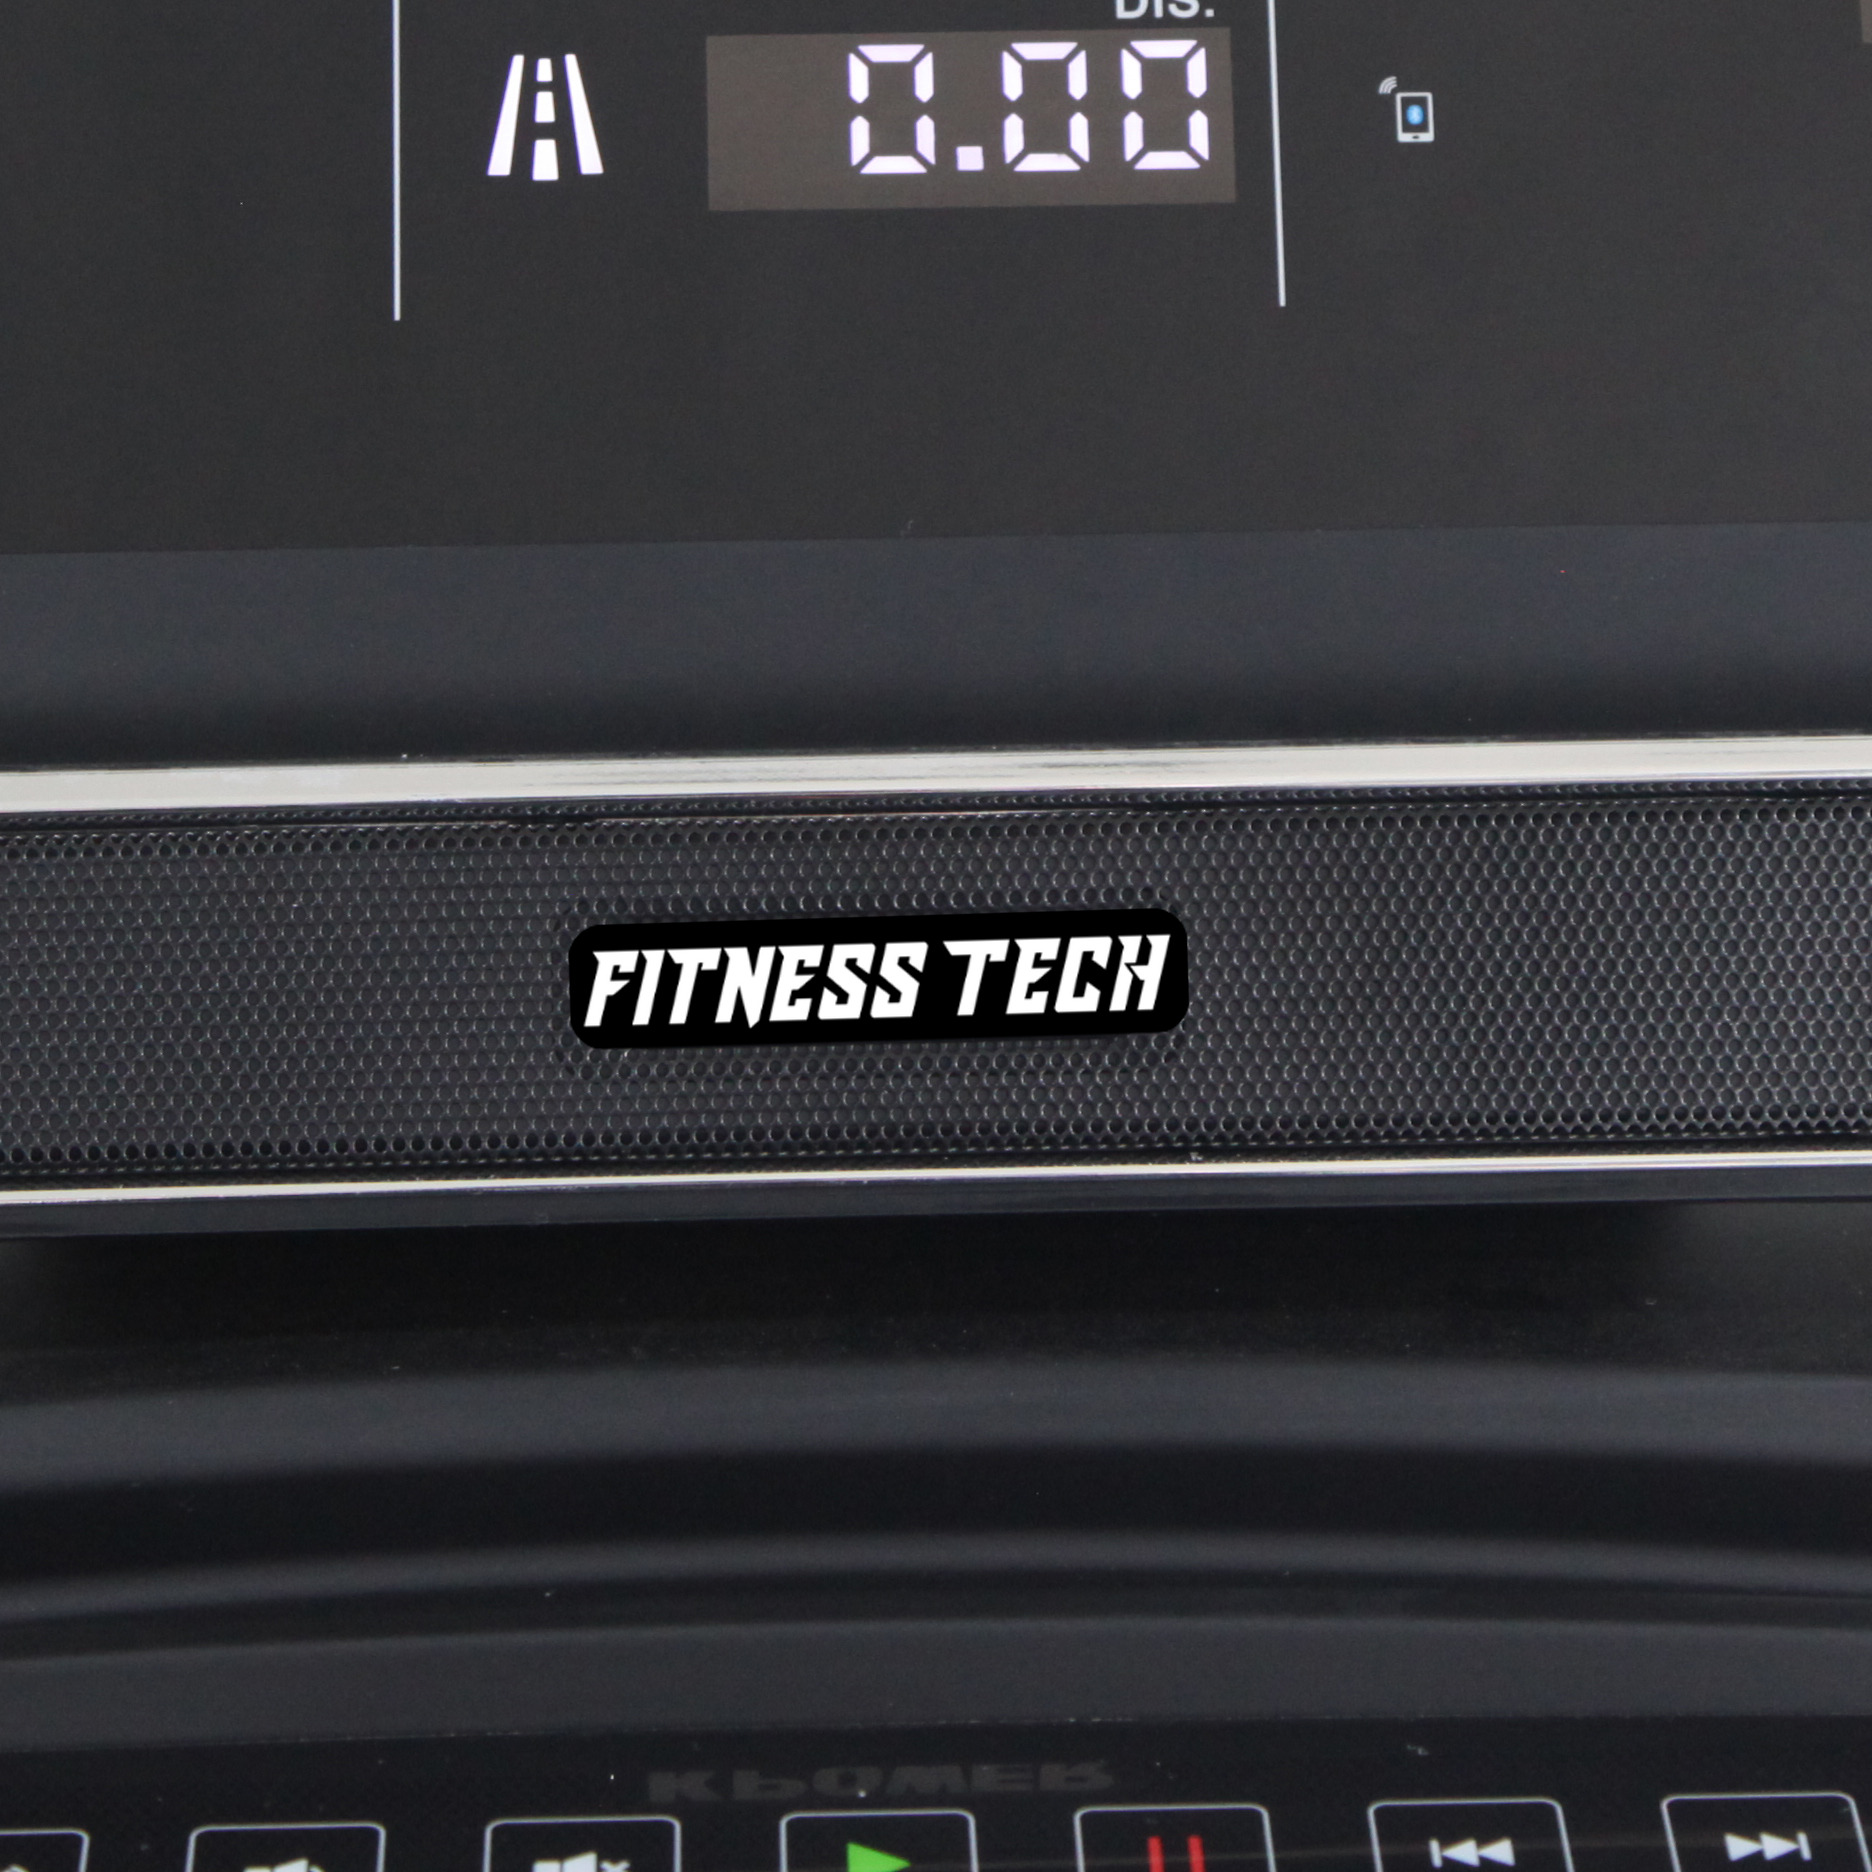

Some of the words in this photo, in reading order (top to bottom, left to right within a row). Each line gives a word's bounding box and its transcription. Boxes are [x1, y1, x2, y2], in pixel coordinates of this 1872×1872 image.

[847, 38, 1211, 176] 0.00
[583, 940, 930, 1029] FITNESS
[942, 933, 1172, 1017] TECH
